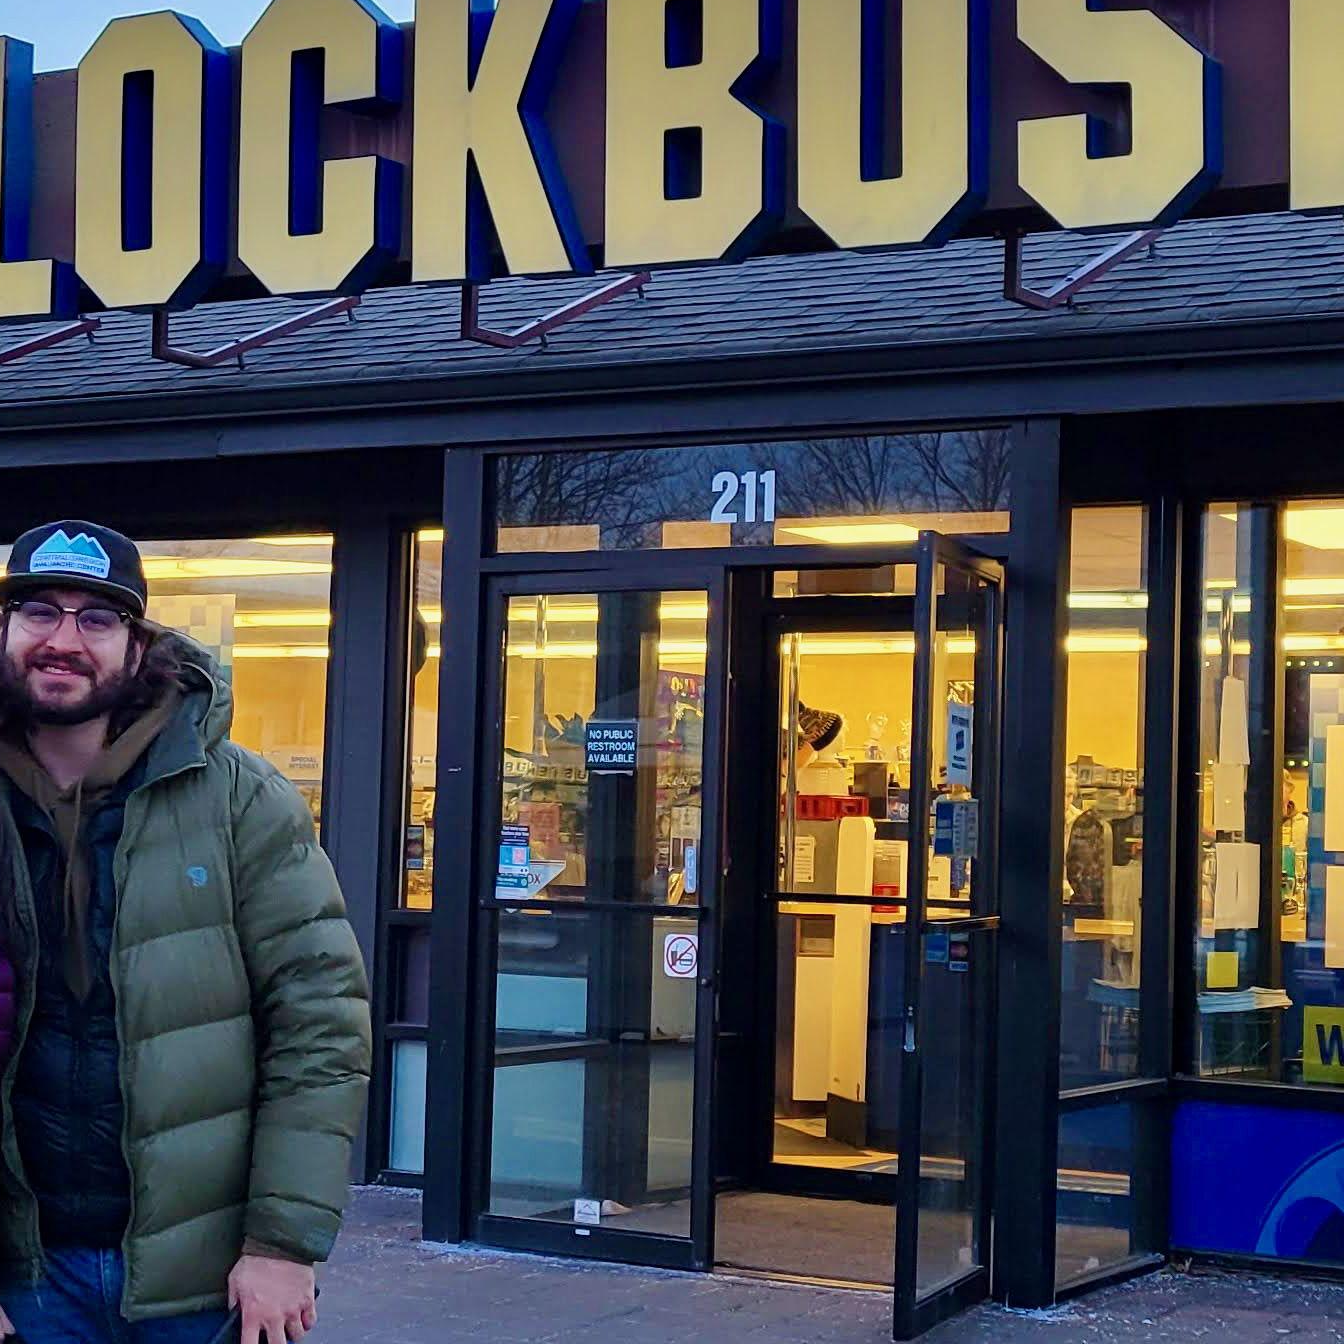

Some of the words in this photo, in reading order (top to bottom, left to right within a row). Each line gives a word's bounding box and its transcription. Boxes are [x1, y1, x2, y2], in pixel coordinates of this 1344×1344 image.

[711, 470, 775, 523] 211
[76, 563, 105, 573] CENTER
[589, 730, 602, 739] NO
[603, 730, 634, 739] PUBLIC
[587, 741, 635, 751] RESTROOM
[587, 753, 635, 763] AVAILABLE
